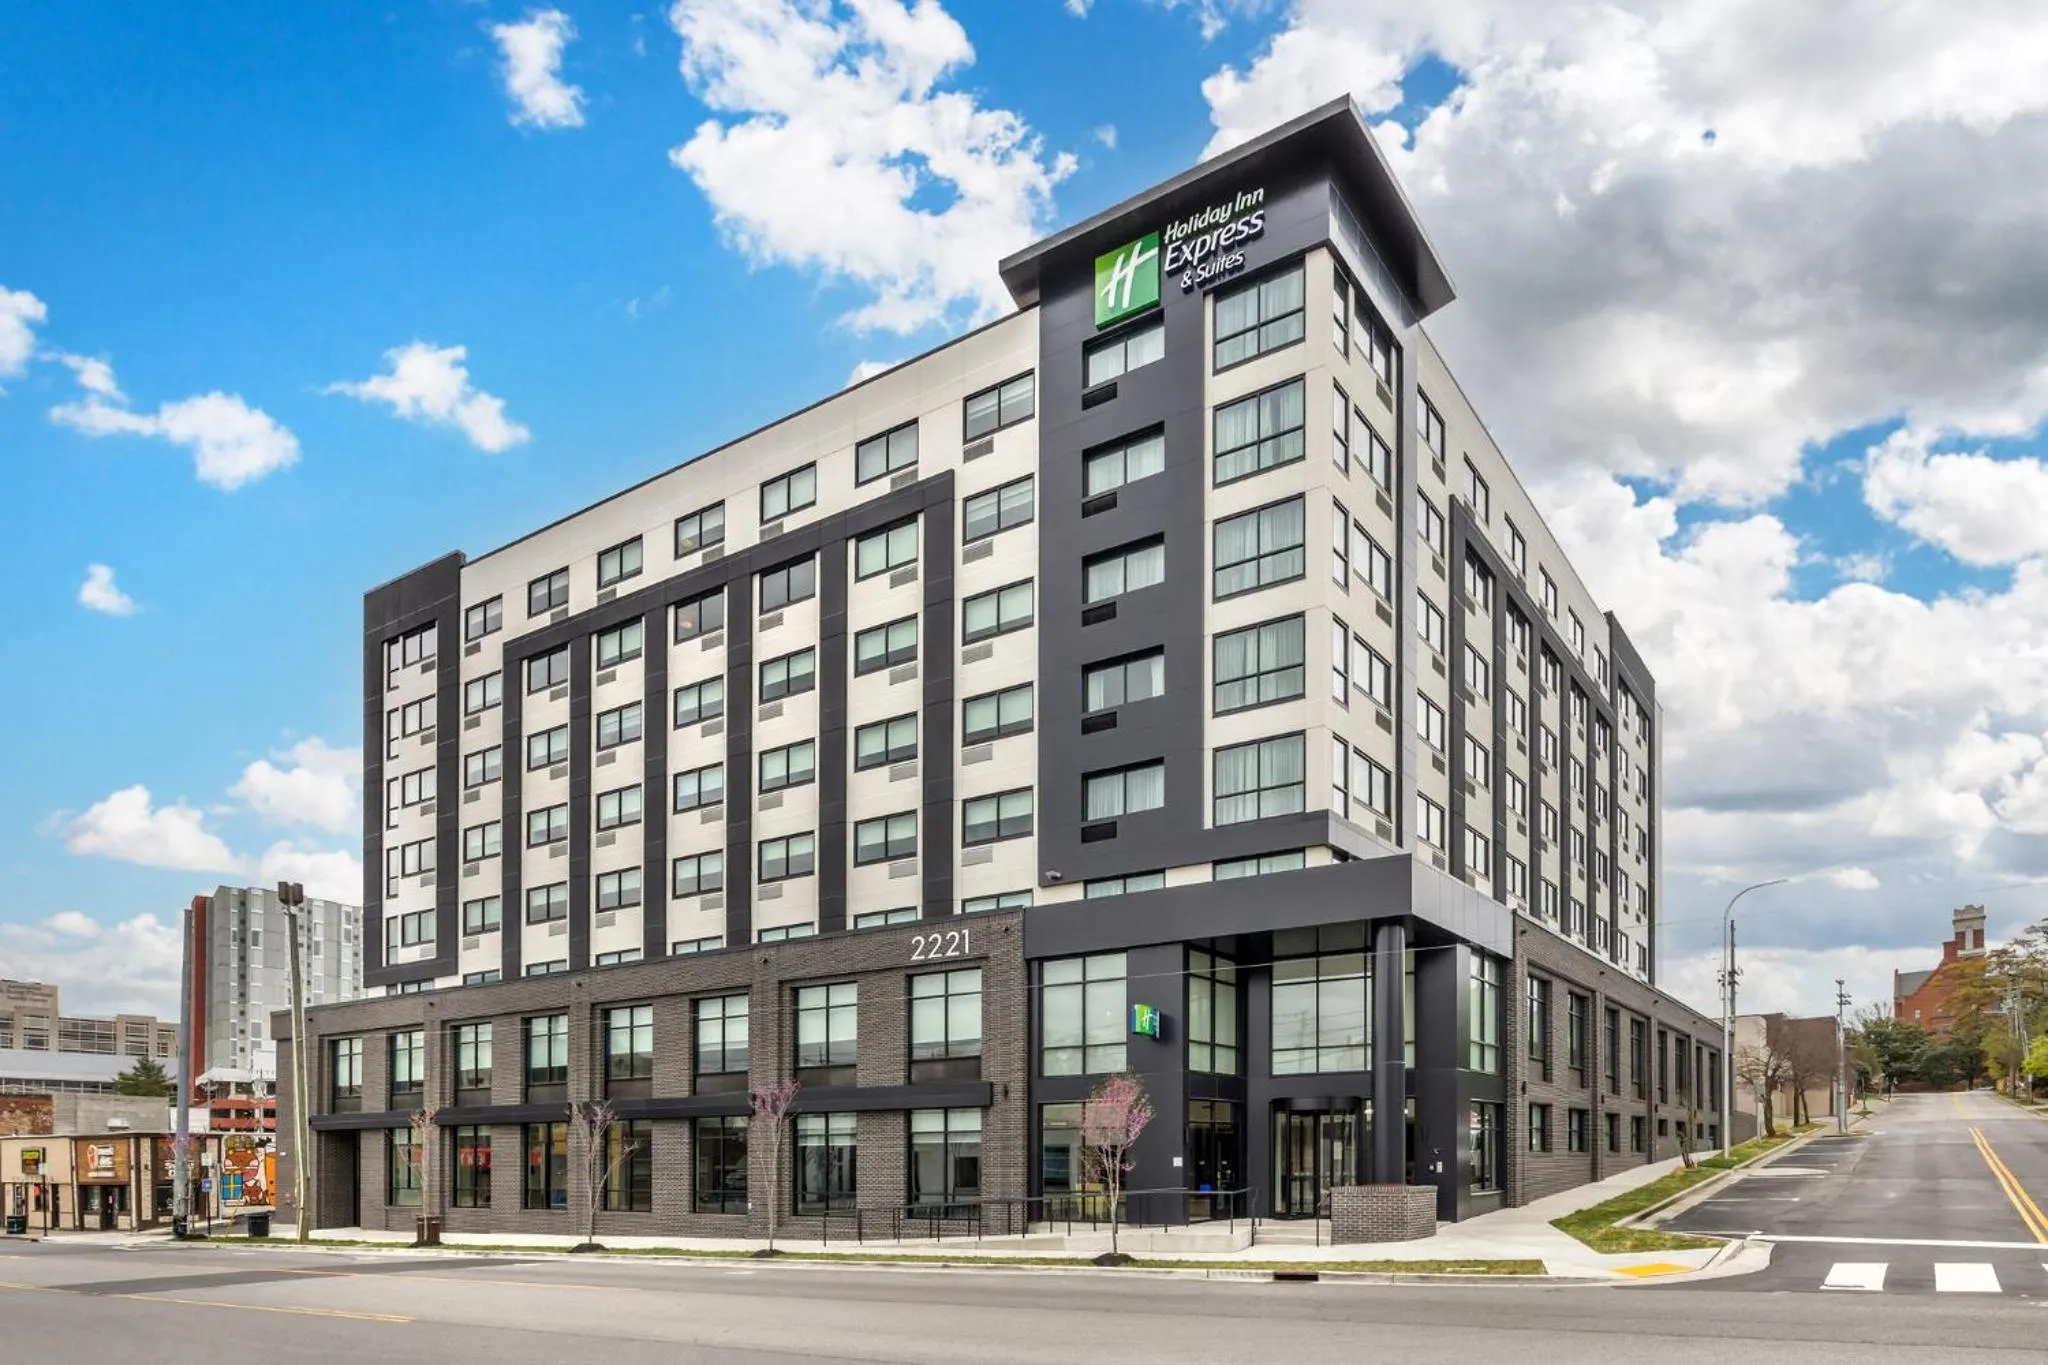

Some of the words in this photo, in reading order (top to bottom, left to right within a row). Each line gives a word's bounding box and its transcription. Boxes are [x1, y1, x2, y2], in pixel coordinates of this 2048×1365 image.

[1163, 202, 1232, 244] Holiday
[1234, 187, 1265, 211] Inn
[1164, 210, 1265, 271] Express
[1180, 269, 1193, 289] &
[1194, 250, 1245, 283] Suites
[911, 929, 969, 960] 2221
